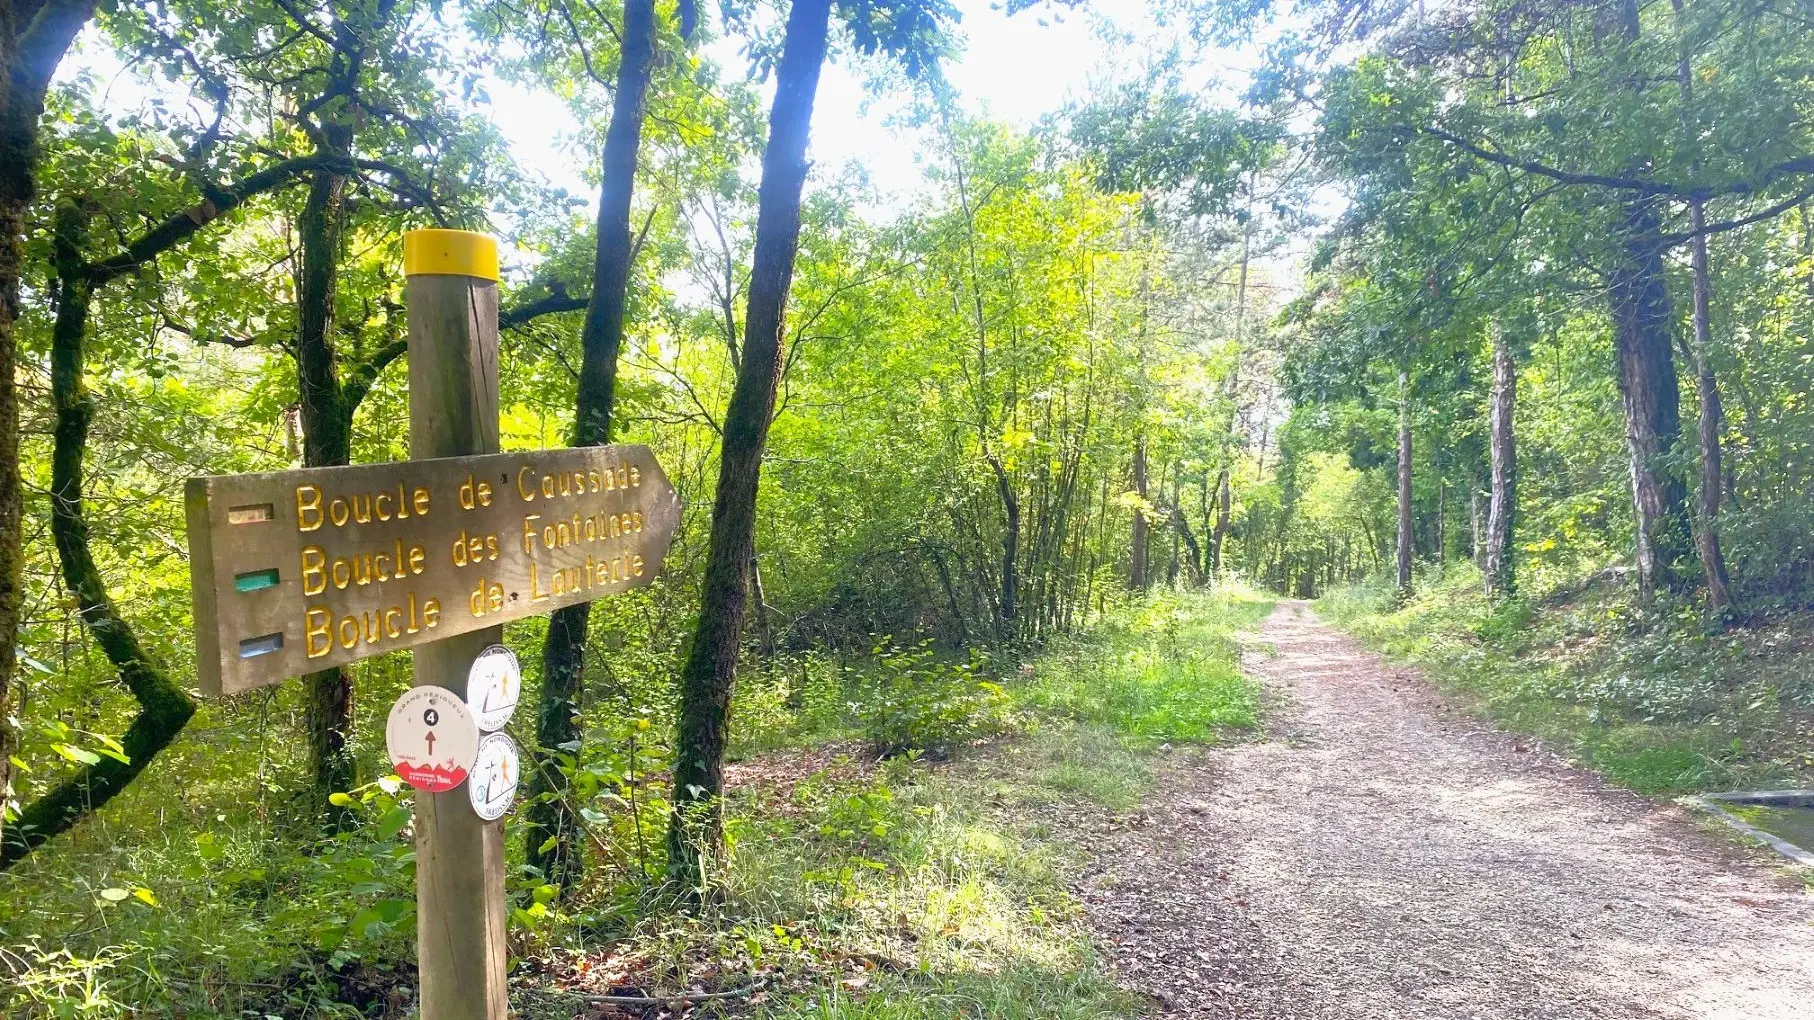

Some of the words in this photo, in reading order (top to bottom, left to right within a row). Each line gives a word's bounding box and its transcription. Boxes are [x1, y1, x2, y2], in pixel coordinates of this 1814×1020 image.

[296, 481, 430, 532] Boucle
[460, 473, 492, 510] de
[518, 460, 641, 501] Caussade
[301, 538, 425, 596] Boucle
[453, 528, 499, 567] des
[524, 509, 643, 554] Fontaines
[306, 591, 441, 659] Boucle
[470, 576, 504, 617] de
[530, 546, 644, 601] Lauterie
[426, 712, 435, 724] 4
